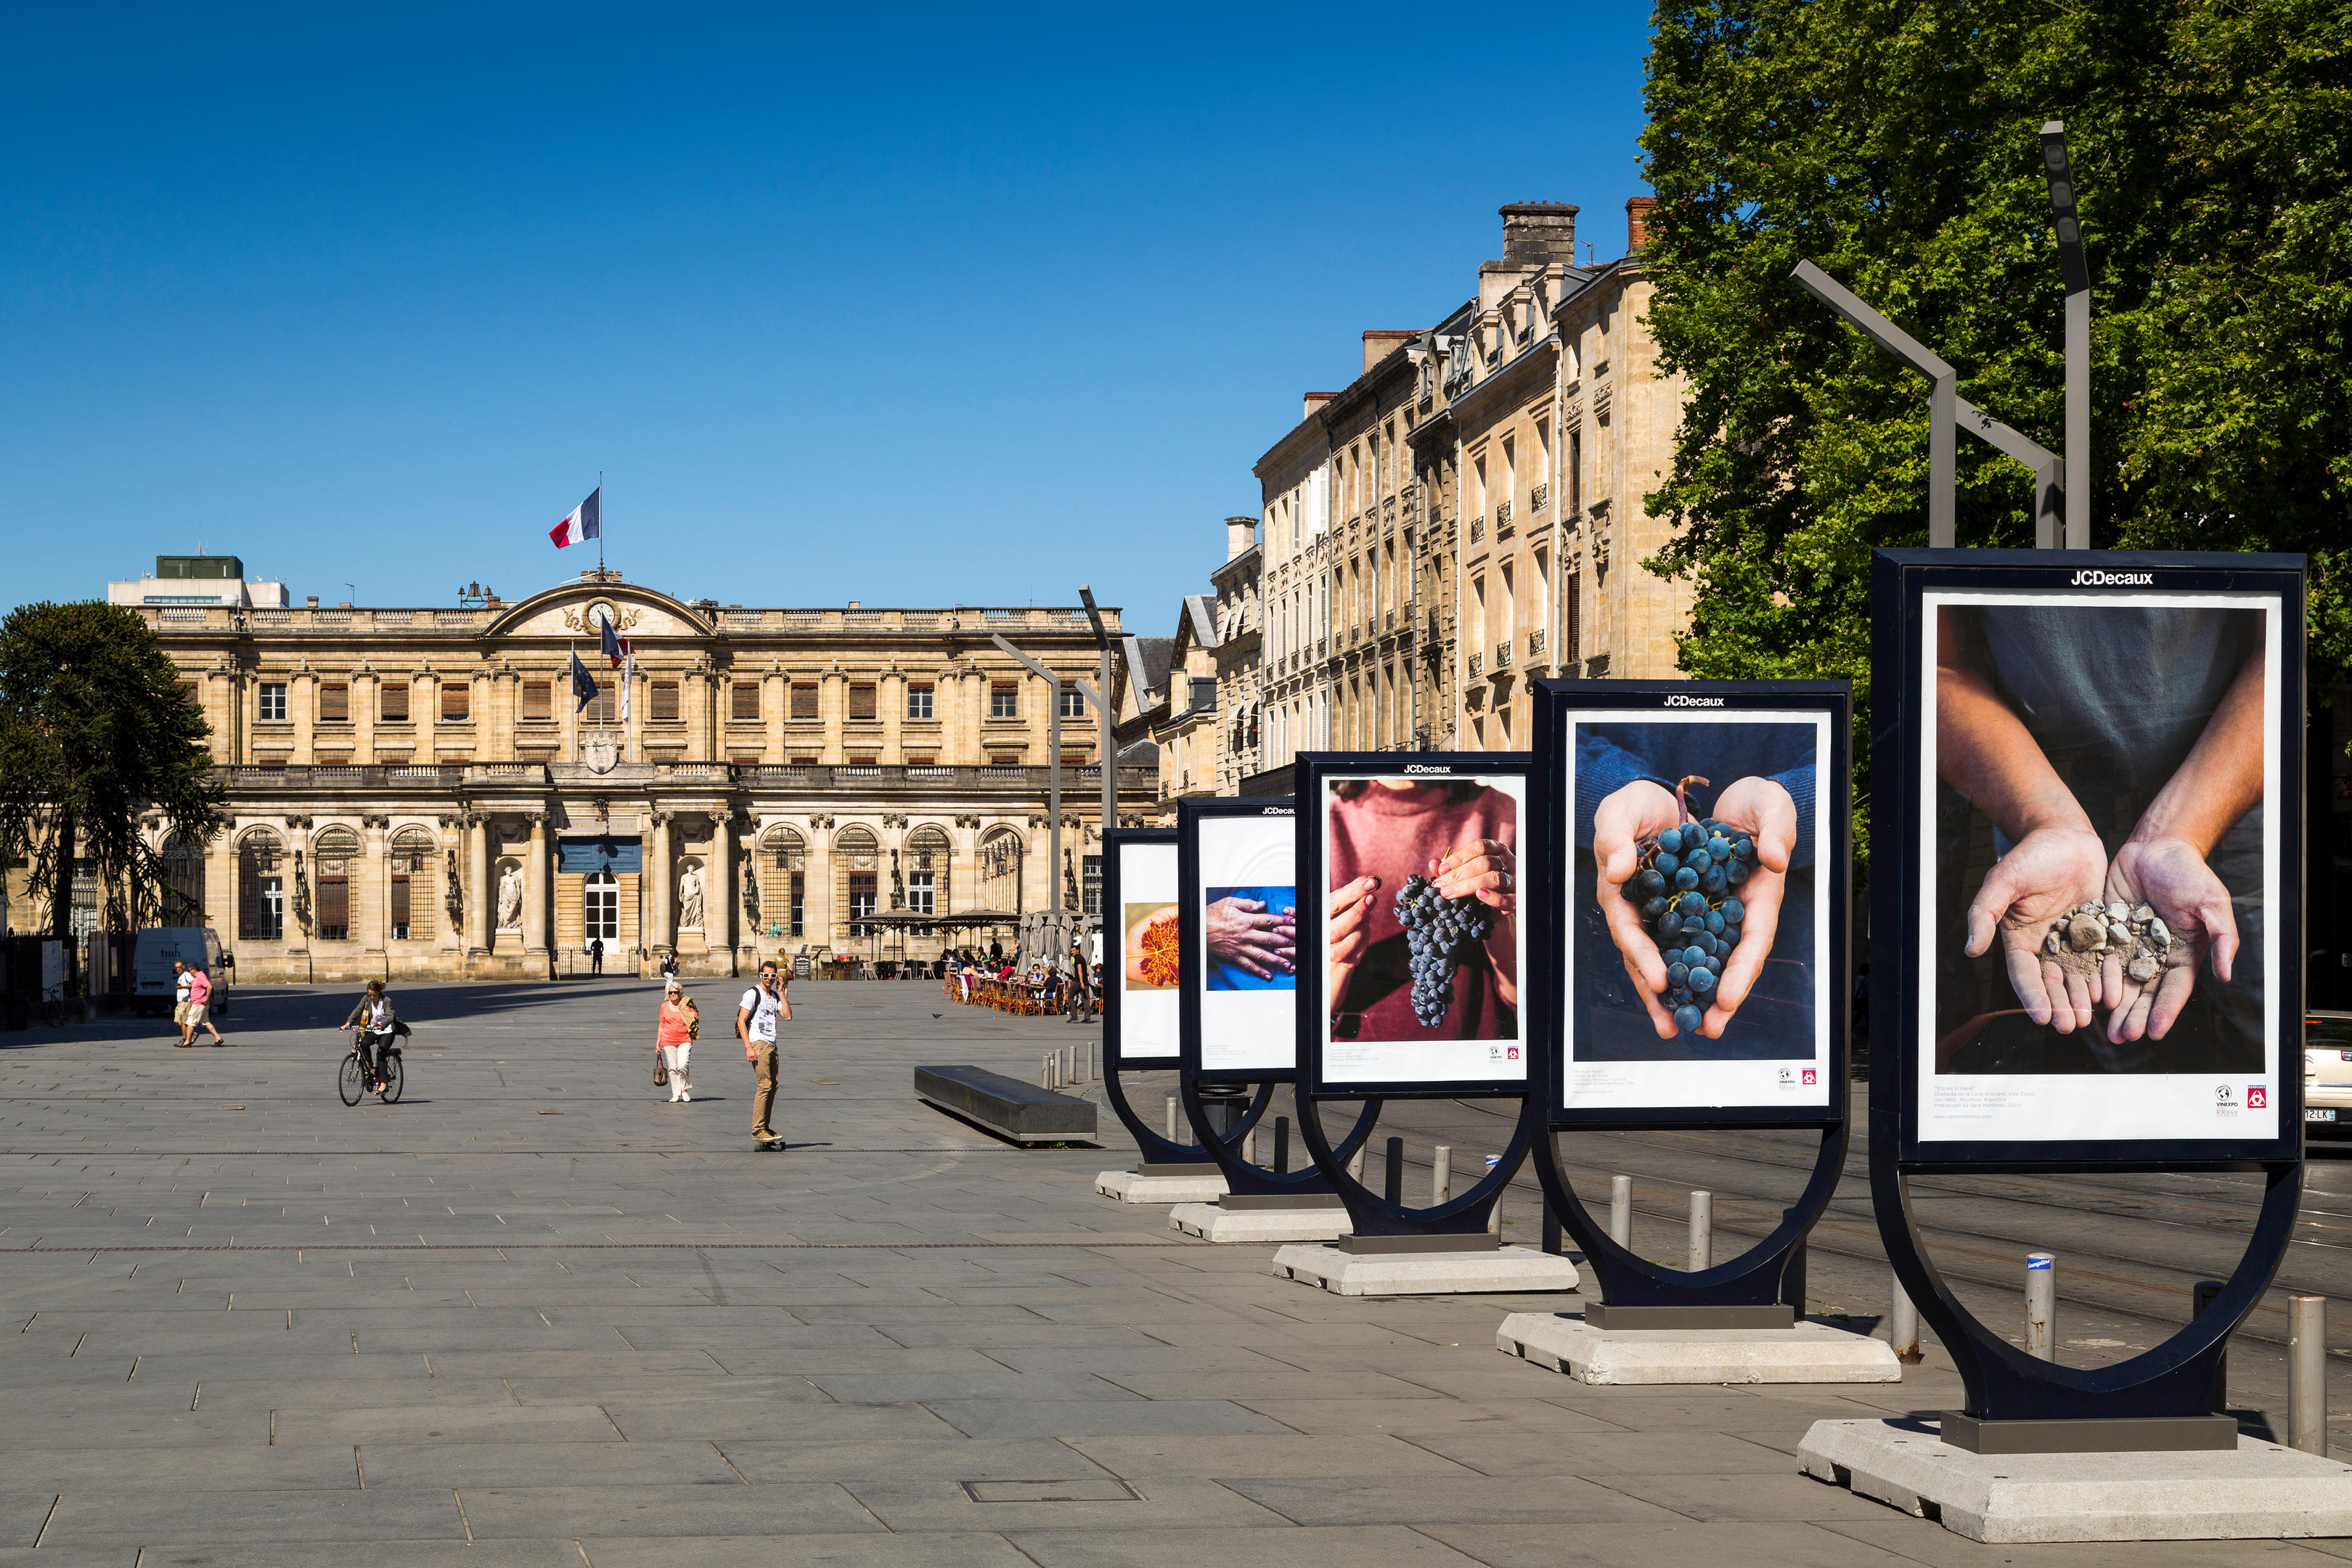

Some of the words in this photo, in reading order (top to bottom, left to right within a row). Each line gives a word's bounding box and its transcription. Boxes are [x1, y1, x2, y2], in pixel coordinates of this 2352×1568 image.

[2071, 570, 2153, 585] JCDecaux
[1664, 695, 1724, 706] JCDecaux
[1404, 764, 1451, 774] JCDecaux
